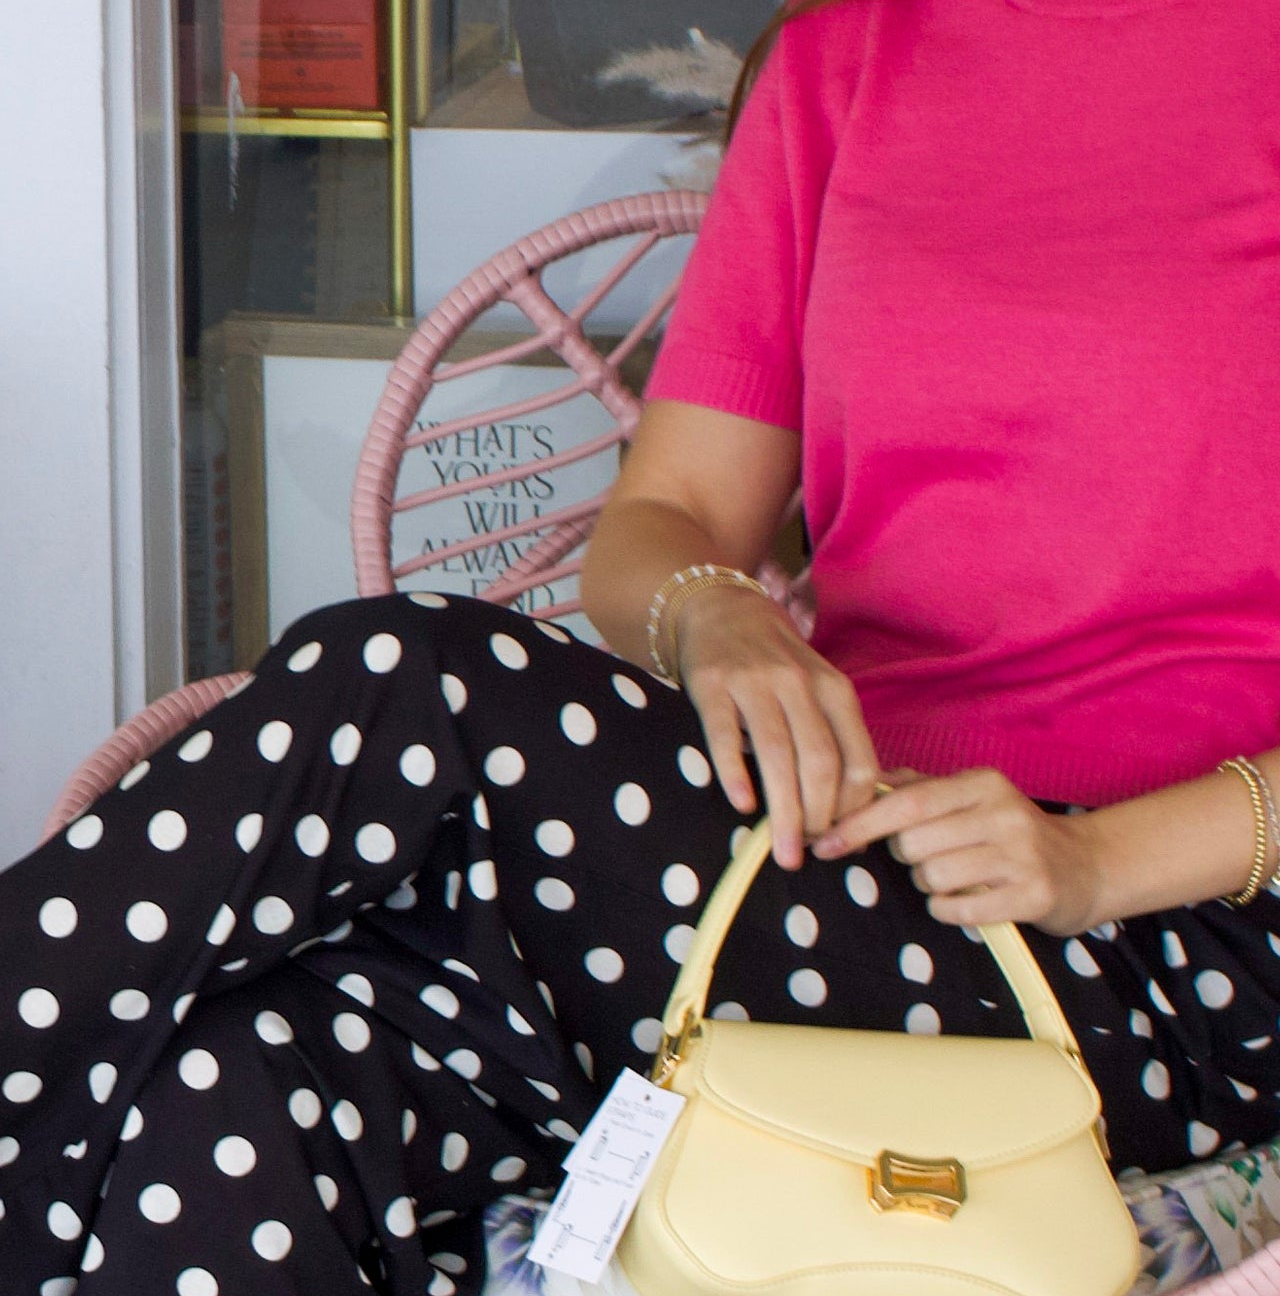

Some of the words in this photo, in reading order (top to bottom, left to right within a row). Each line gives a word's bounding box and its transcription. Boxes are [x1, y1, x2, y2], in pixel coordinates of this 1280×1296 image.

[417, 421, 554, 459] WHAT'S
[464, 501, 544, 537] WILL
[422, 538, 536, 574] ALWAY
